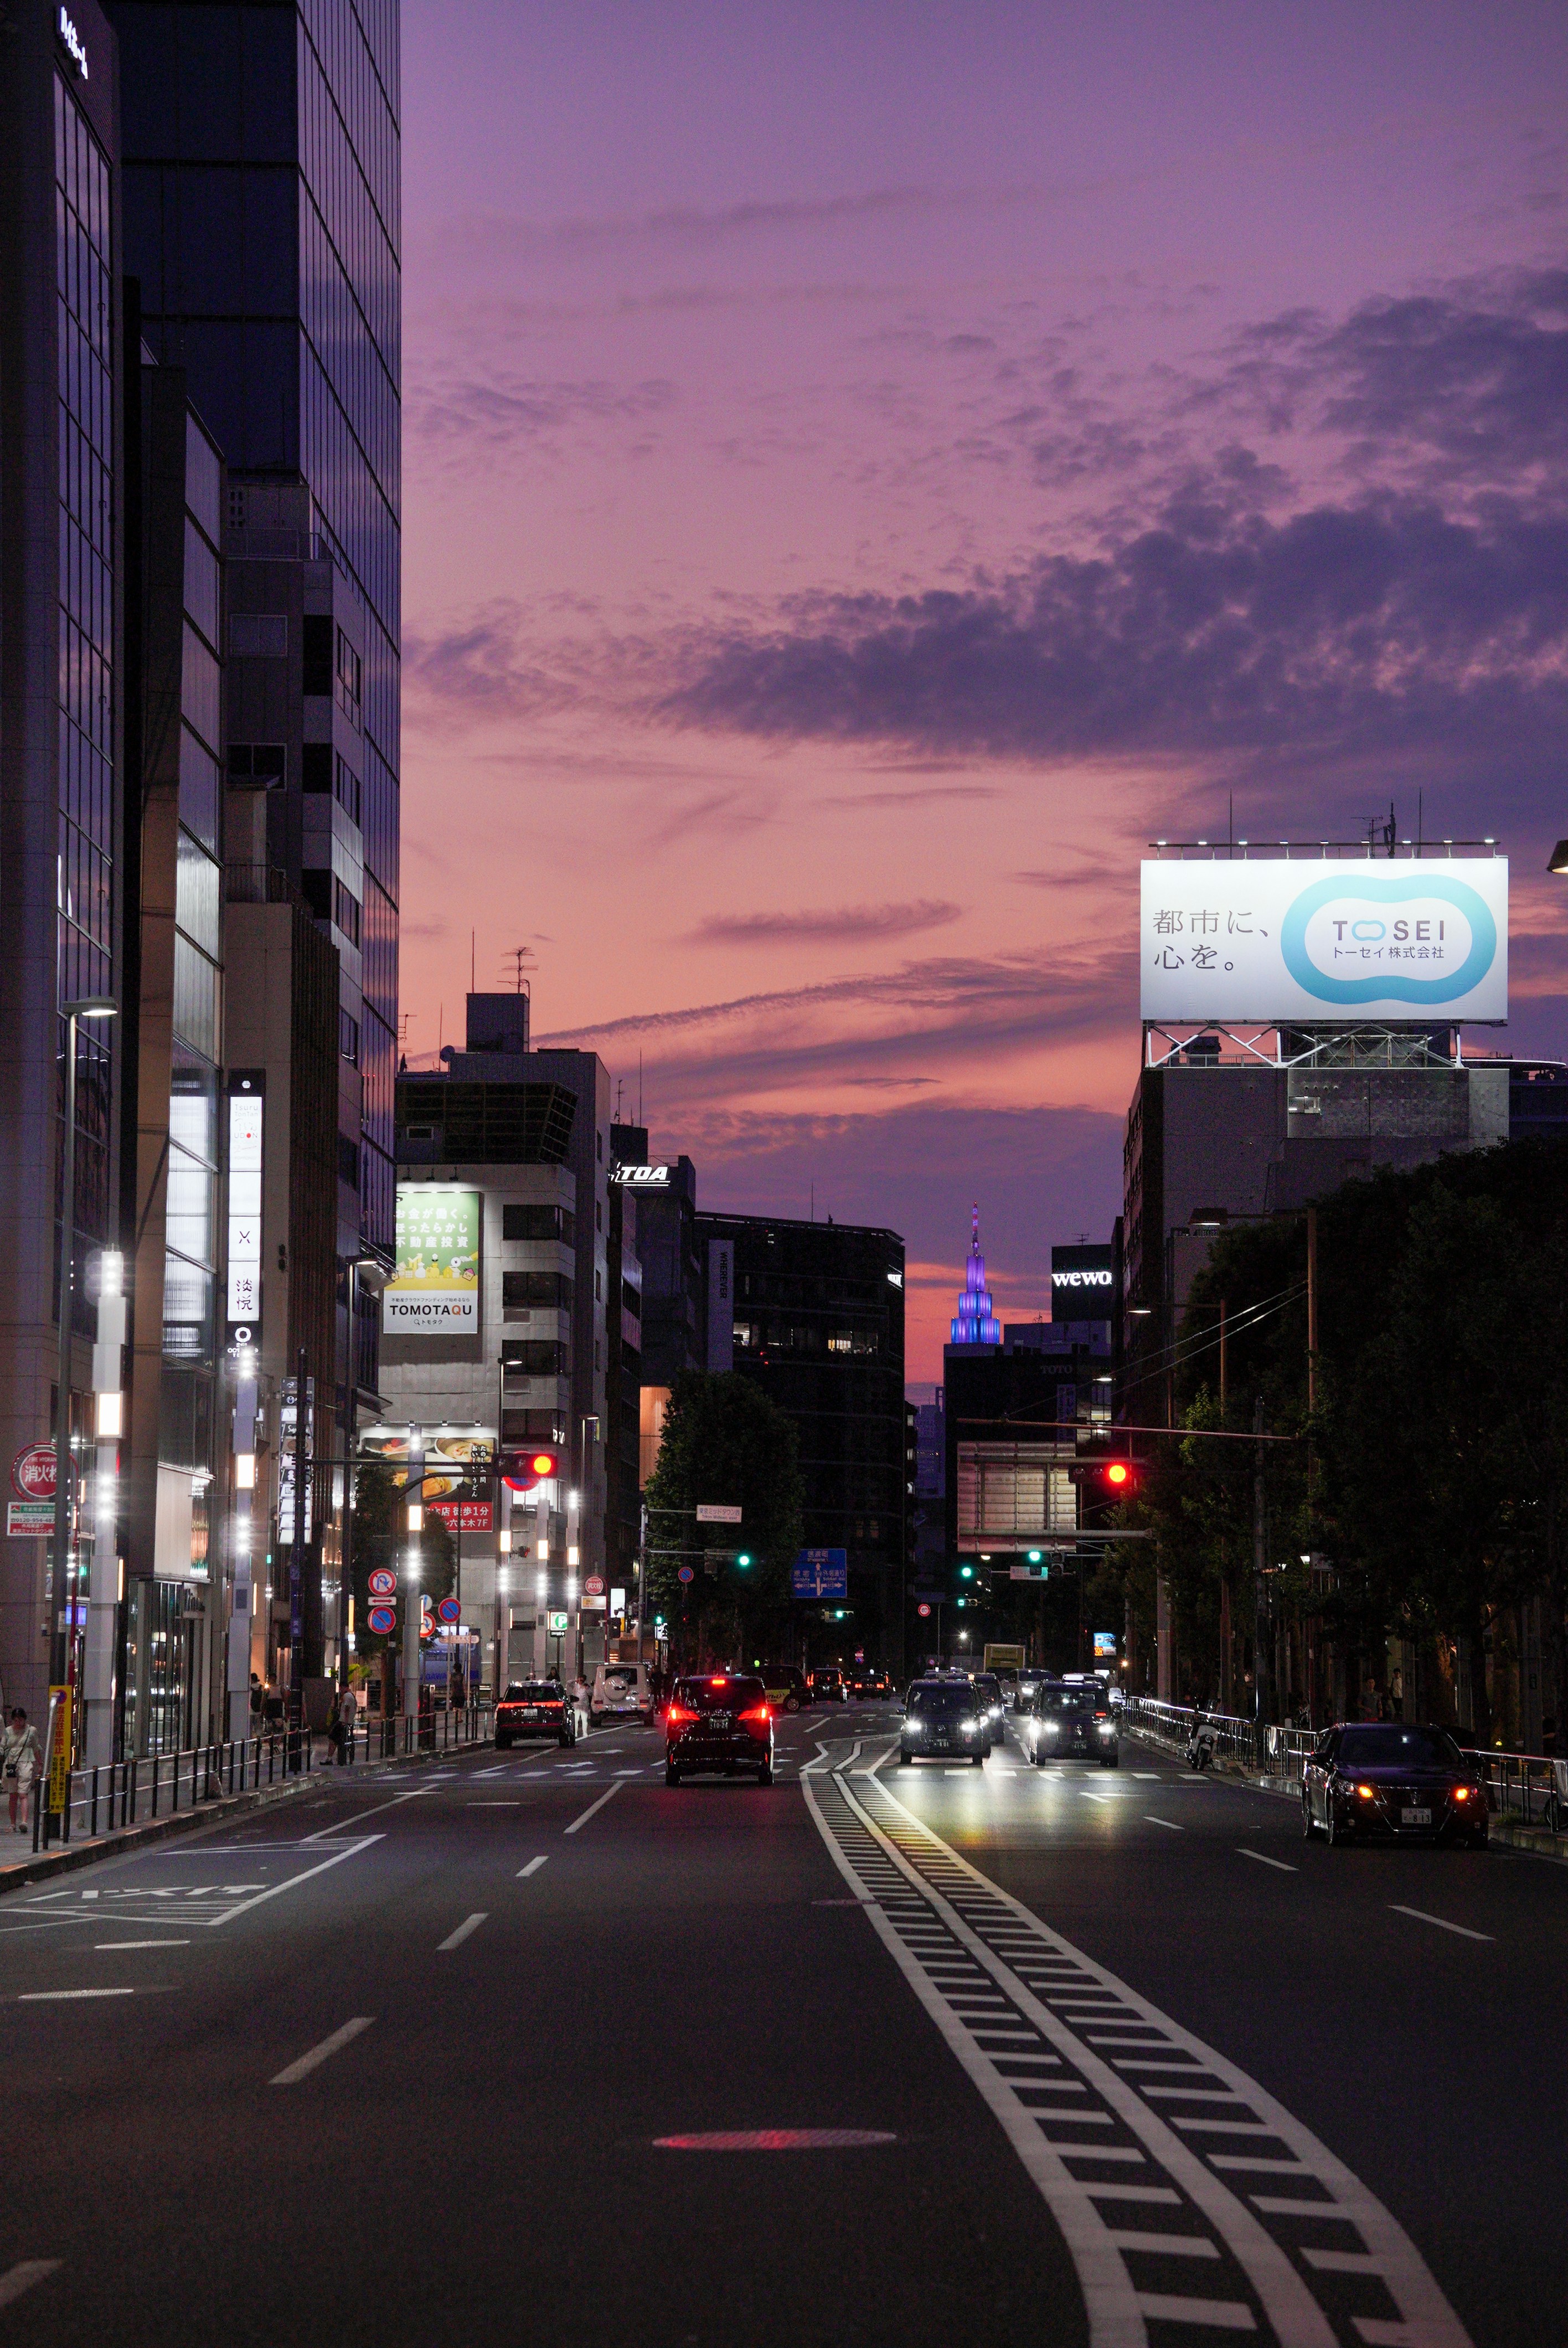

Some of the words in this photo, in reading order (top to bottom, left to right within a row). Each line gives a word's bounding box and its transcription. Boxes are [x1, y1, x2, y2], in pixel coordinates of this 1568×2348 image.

[1153, 910, 1268, 937] 都市に、
[1154, 945, 1234, 971] 心を。
[1333, 946, 1444, 959] トーセイ株式会社
[621, 1166, 668, 1180] TOA
[396, 1208, 468, 1219] お金が働く。
[396, 1222, 467, 1233] ほったらかし
[396, 1236, 468, 1248] 不動産投資
[1051, 1271, 1112, 1286] wewo
[236, 1279, 253, 1310] 淡悦
[390, 1305, 472, 1316] TOMOTAQU
